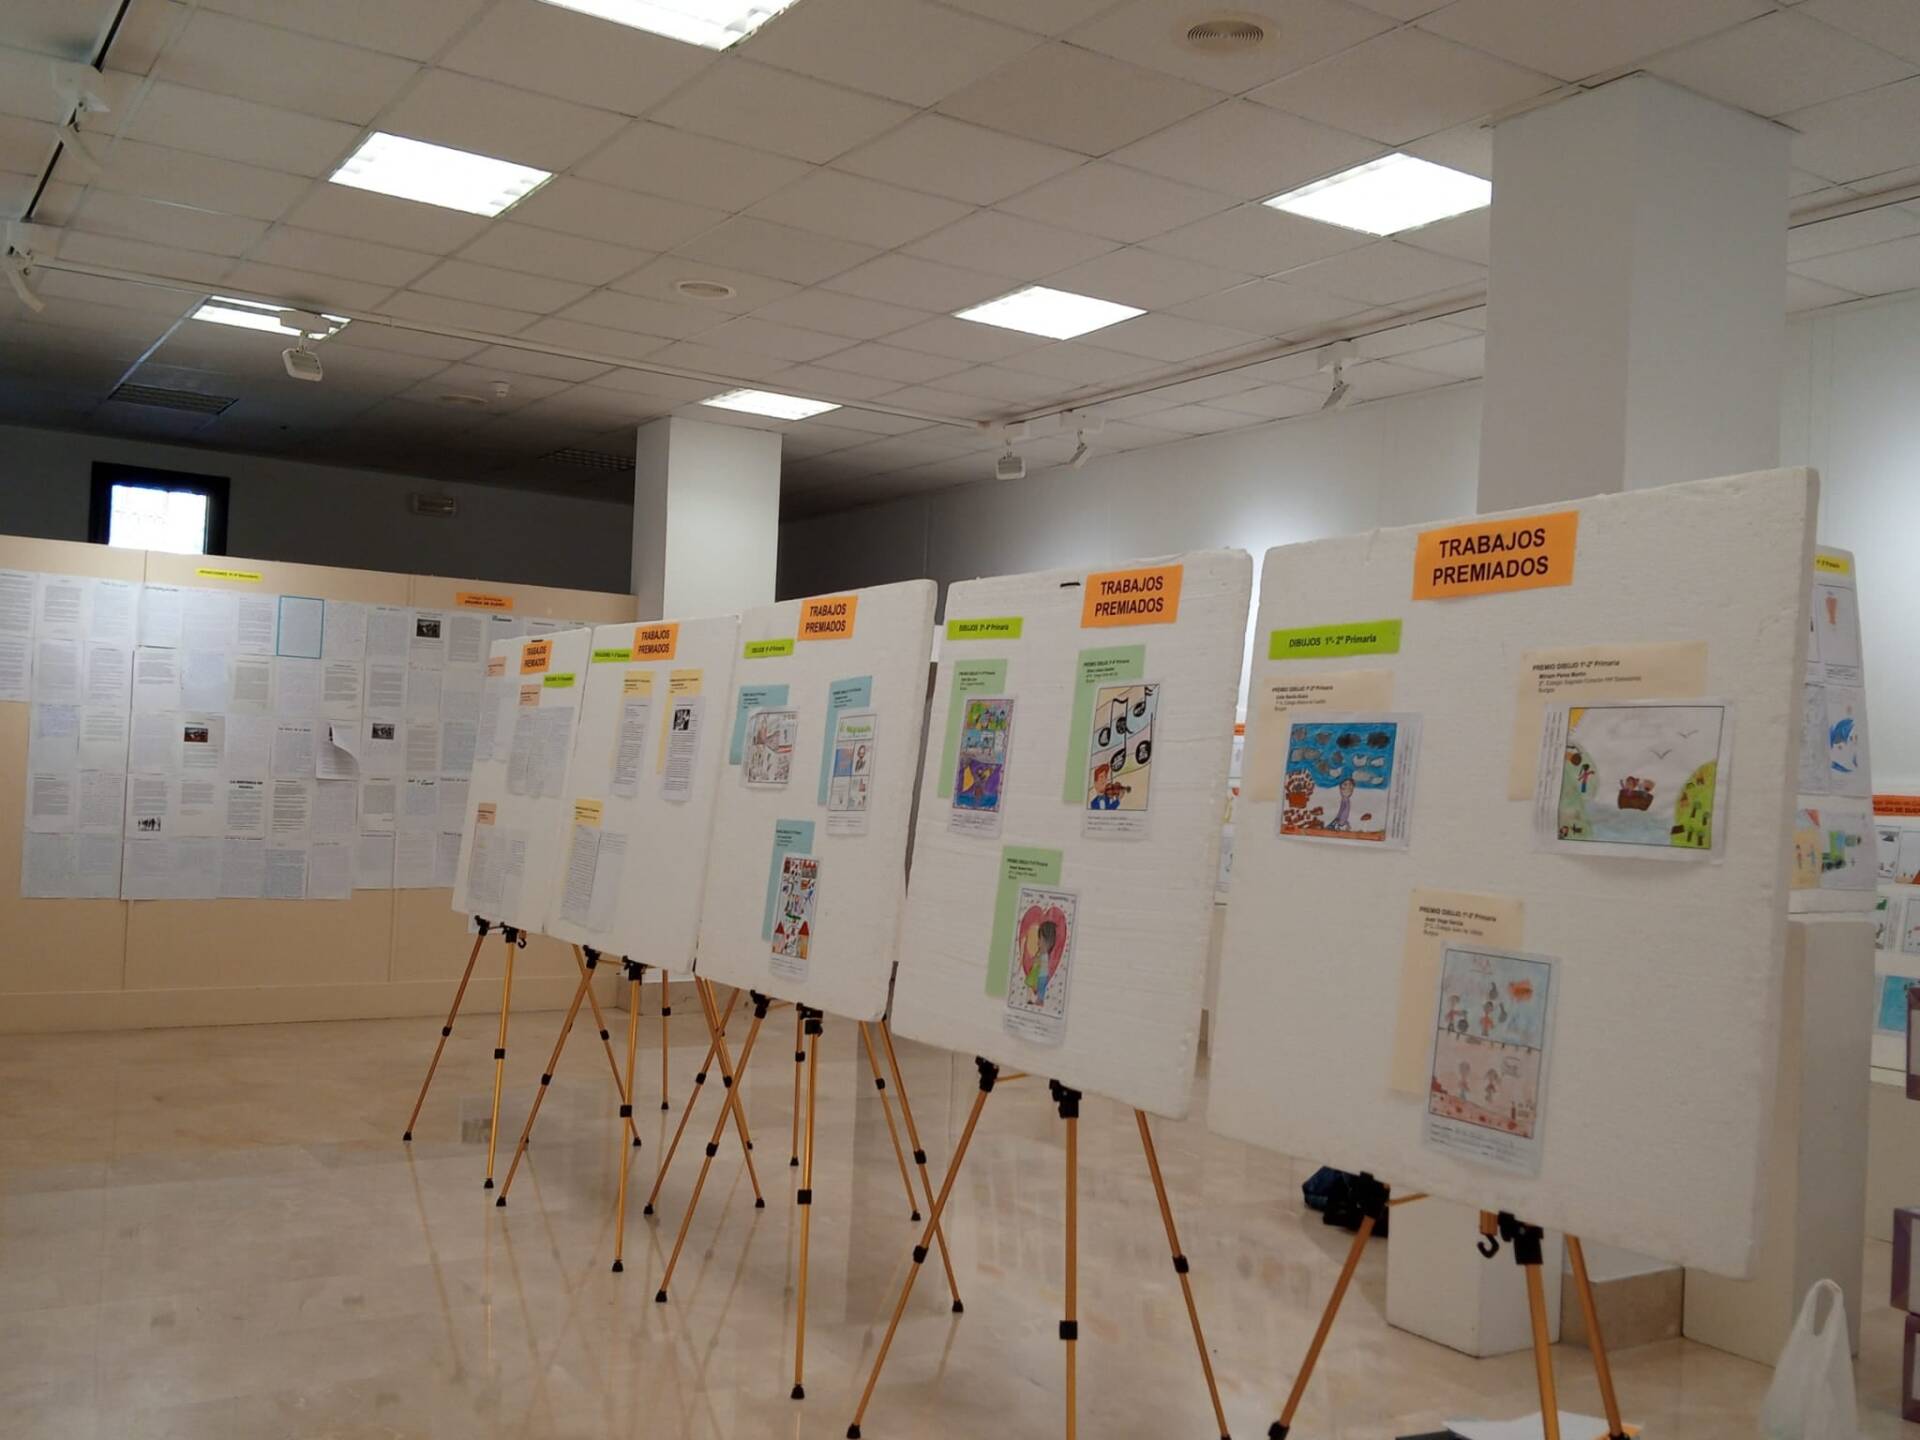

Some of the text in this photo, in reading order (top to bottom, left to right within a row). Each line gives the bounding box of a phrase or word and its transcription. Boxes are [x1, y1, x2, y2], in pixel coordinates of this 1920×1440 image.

[1439, 528, 1546, 558] TRABAJOS
[1432, 556, 1549, 586] PREMIADOS
[1101, 576, 1164, 595] TRABAJOS
[809, 603, 847, 617] TRABAJOS
[1095, 597, 1164, 616] PREMIADOS
[805, 620, 847, 633] PREMIADOS
[641, 630, 670, 641] TRABAJOS
[1289, 636, 1321, 648] DIBUJOS
[1345, 633, 1377, 645] Primaria
